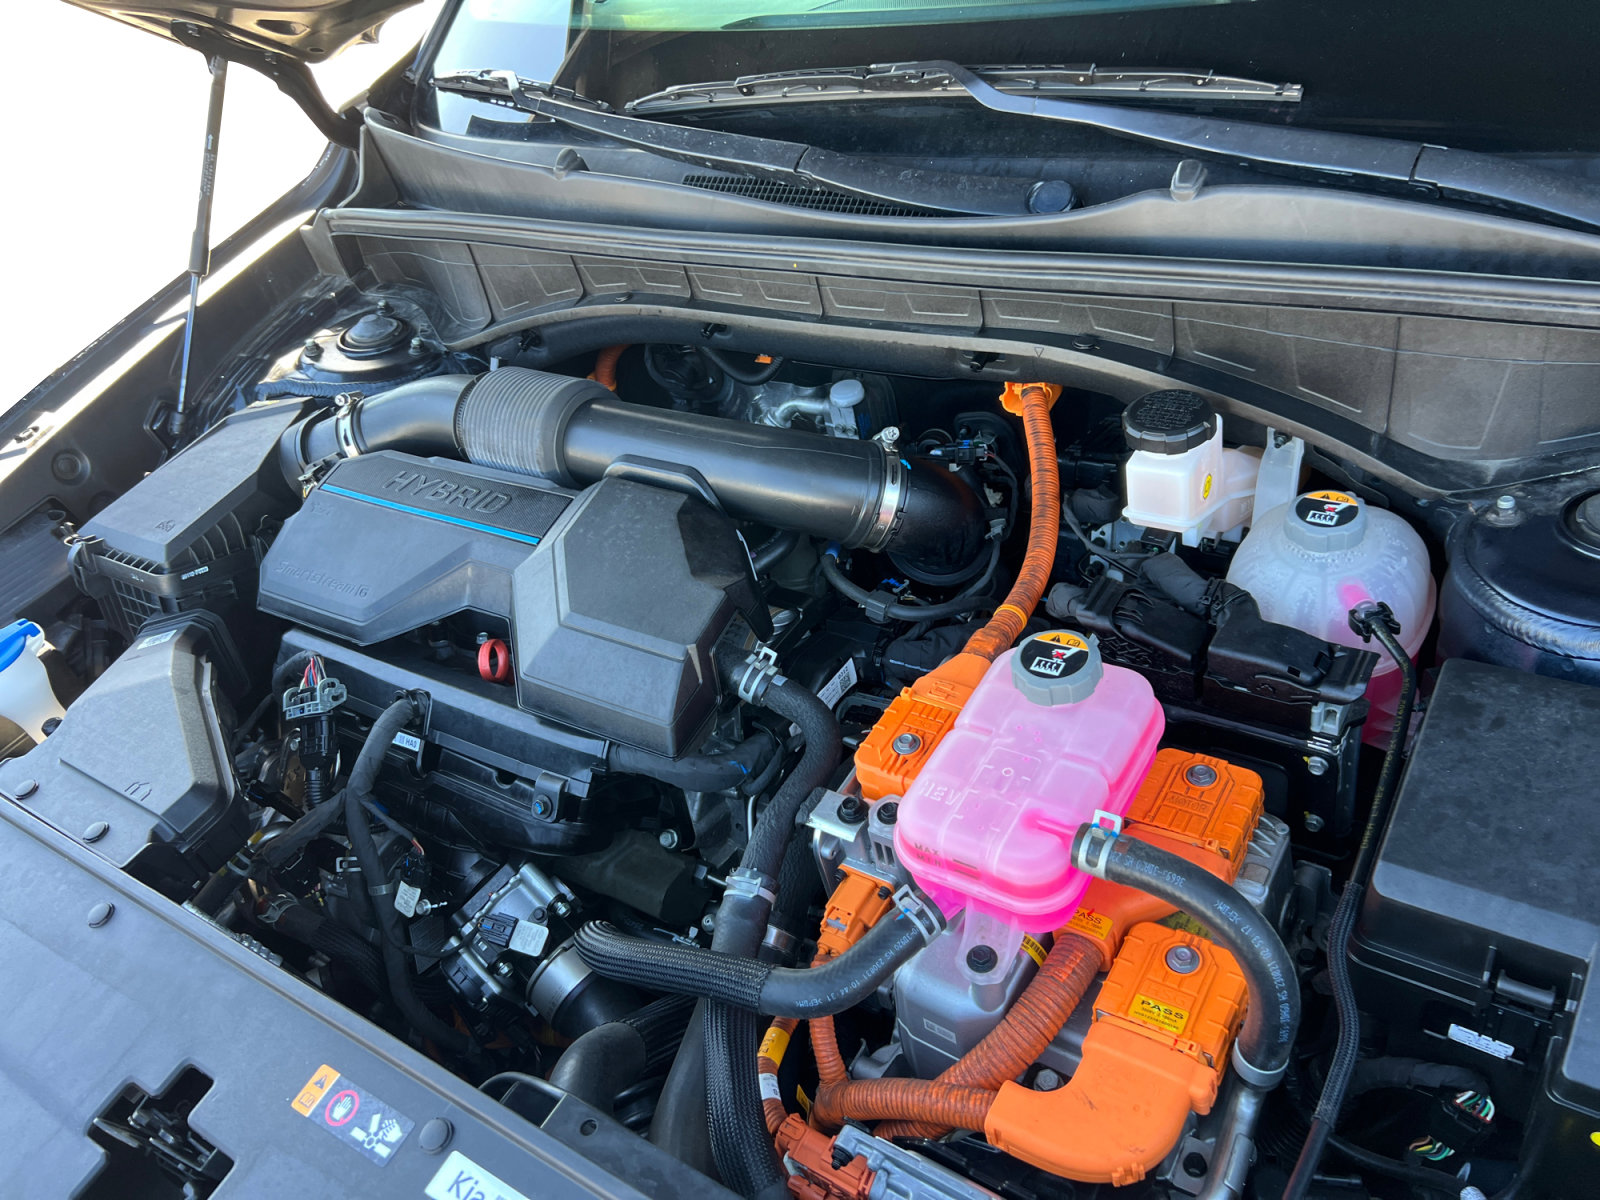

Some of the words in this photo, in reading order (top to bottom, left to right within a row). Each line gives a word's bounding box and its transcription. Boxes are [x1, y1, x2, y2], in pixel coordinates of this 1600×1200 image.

[382, 470, 512, 514] HYBRID
[913, 842, 939, 856] MAX
[1140, 999, 1185, 1021] PASS
